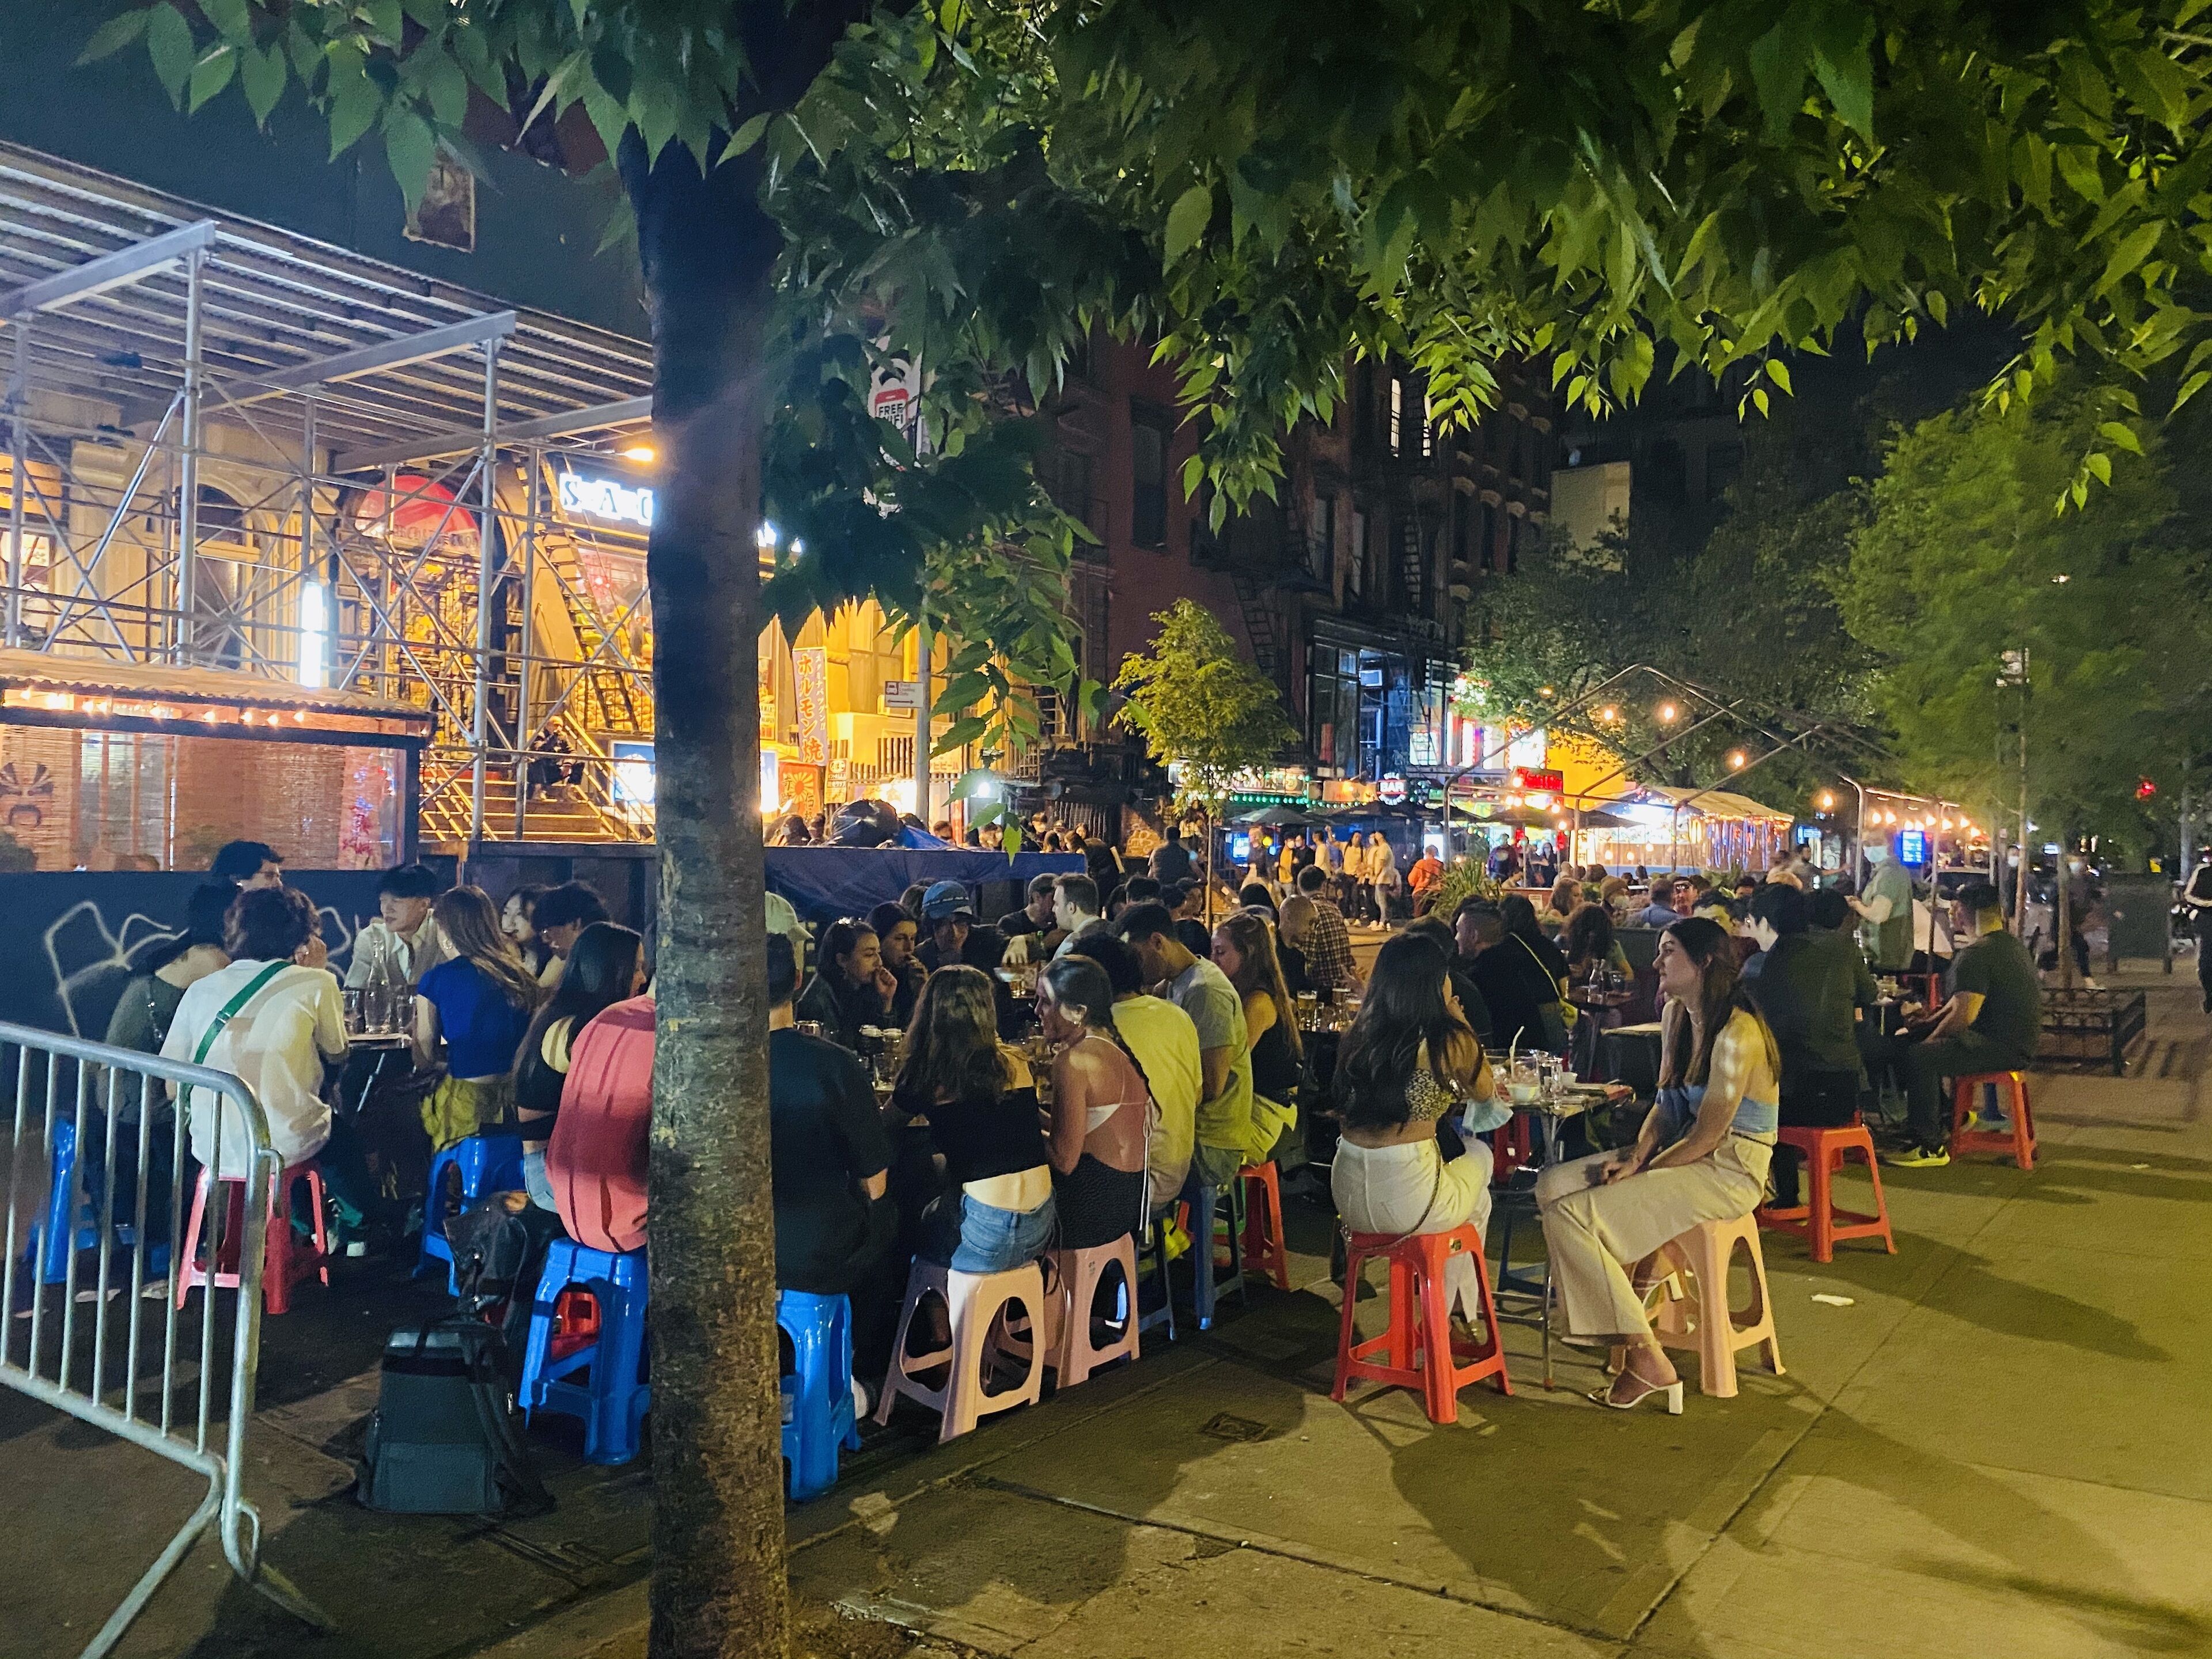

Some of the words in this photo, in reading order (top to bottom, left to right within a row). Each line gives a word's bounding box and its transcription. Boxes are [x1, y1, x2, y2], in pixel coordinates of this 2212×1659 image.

[878, 403, 903, 416] FREE
[885, 414, 903, 425] IFI
[797, 653, 825, 763] ホルモン焼
[1380, 781, 1404, 793] BAR
